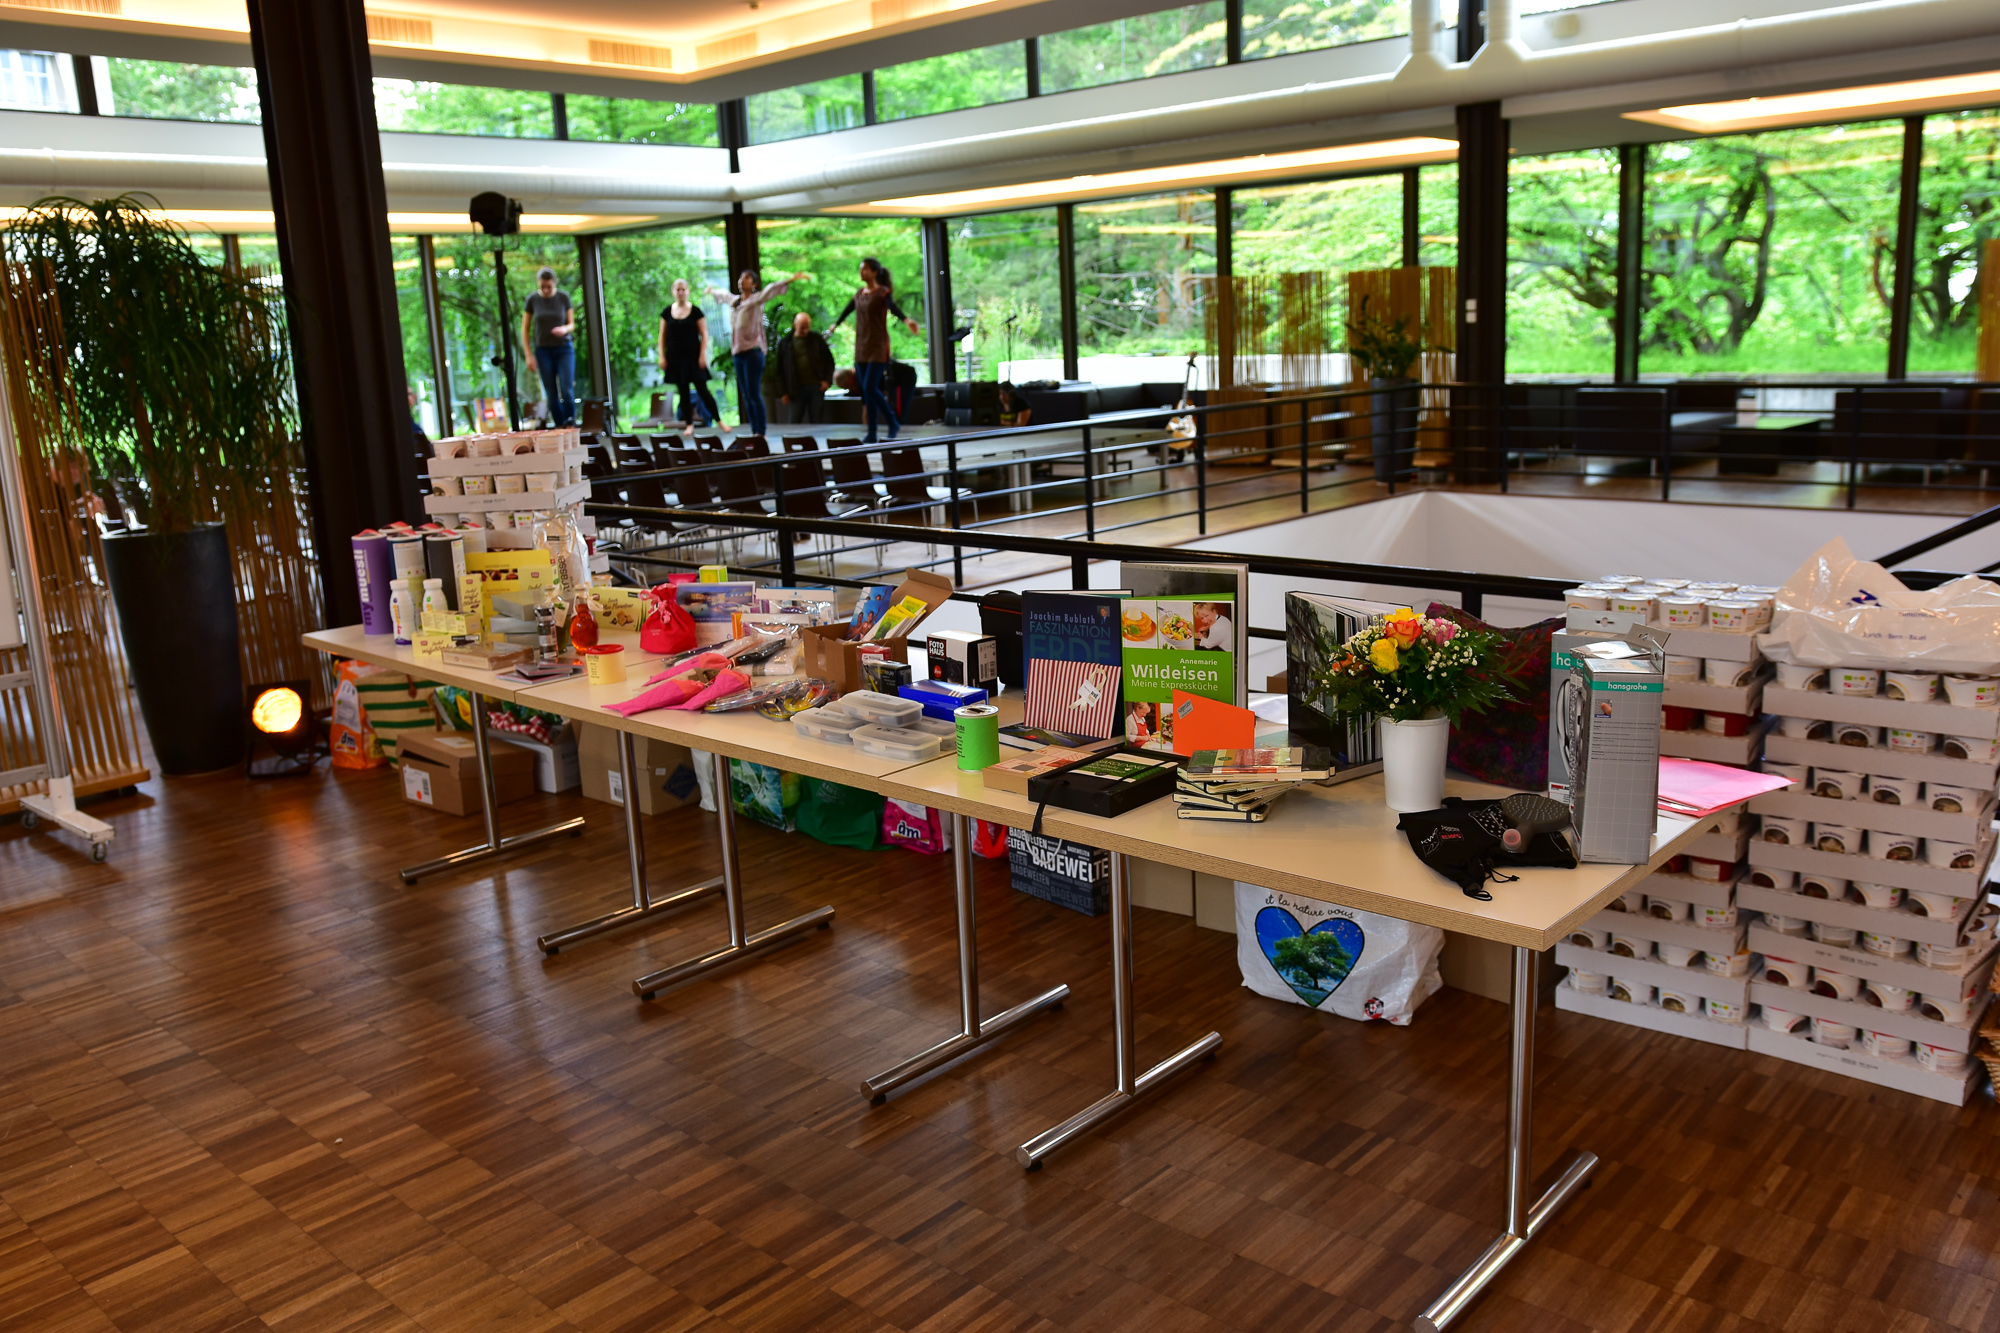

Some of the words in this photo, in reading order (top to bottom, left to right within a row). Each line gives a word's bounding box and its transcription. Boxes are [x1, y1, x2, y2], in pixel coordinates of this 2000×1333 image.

[353, 549, 374, 626] mymuesli
[1029, 611, 1061, 622] Joachim
[1064, 613, 1096, 625] Bublath
[1029, 620, 1111, 639] FASZINATION
[928, 640, 944, 649] FOTO
[929, 647, 945, 656] HAUS
[1179, 657, 1218, 666] Annemarie
[1131, 664, 1218, 682] Wildeisen
[1131, 679, 1158, 689] Meine
[1160, 680, 1219, 692] Expressküche
[1607, 681, 1648, 692] hansgrohe
[897, 821, 920, 840] dm
[1010, 862, 1050, 886] BADEWELTEN
[1265, 894, 1275, 905] et
[1278, 893, 1291, 907] la
[1292, 901, 1325, 917] nature
[1327, 908, 1355, 919] vous
